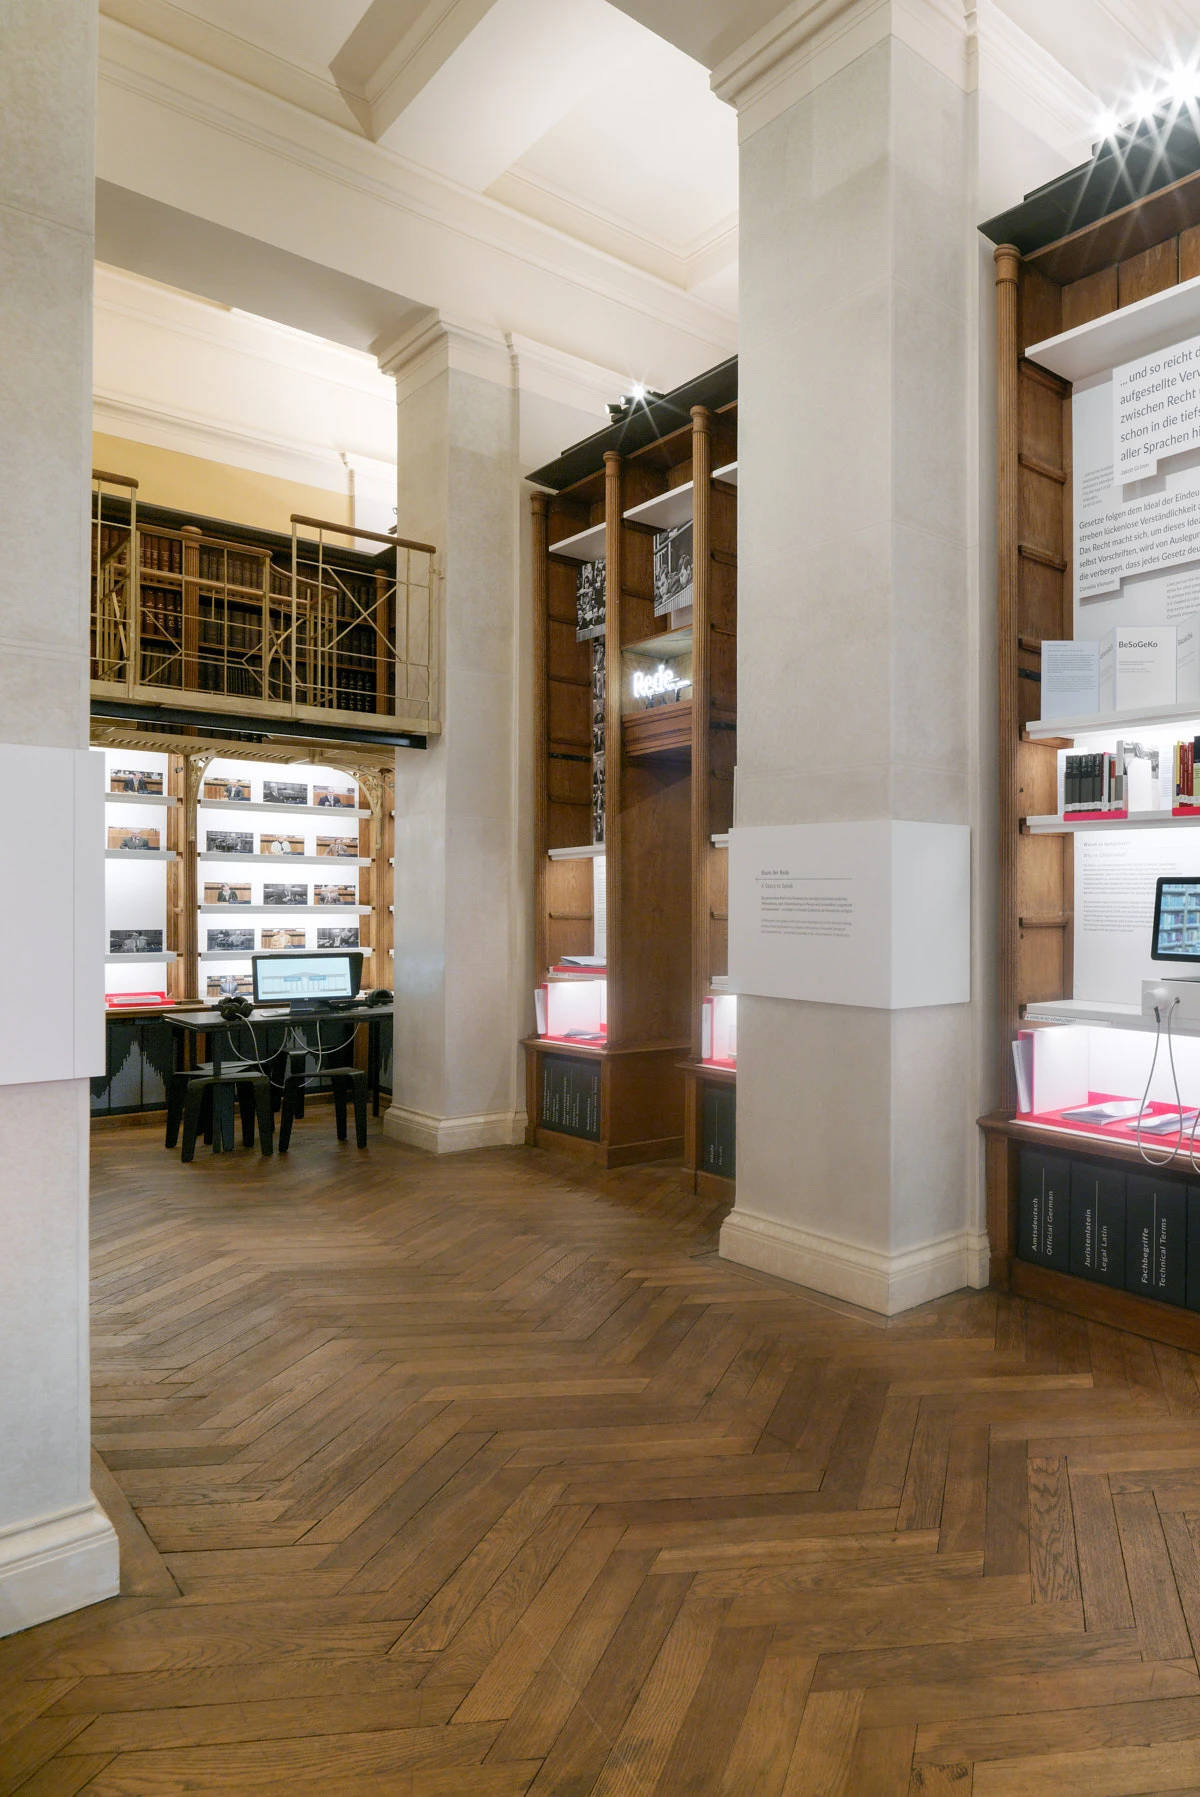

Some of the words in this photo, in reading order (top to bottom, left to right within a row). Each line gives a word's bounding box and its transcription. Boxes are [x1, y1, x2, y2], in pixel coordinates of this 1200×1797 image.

[1150, 364, 1160, 375] so
[1164, 351, 1192, 370] reicht
[1120, 377, 1177, 405] aufgestellte
[1120, 401, 1164, 423] zwischen
[1168, 389, 1196, 407] Recht
[1121, 427, 1148, 442] schon
[1152, 422, 1159, 432] in
[1163, 416, 1177, 428] die
[1121, 448, 1140, 462] aller
[1144, 430, 1189, 454] Sprachen
[1134, 463, 1149, 471] Grimm
[1079, 516, 1104, 529] Gesetze
[1106, 510, 1126, 522] folgen
[1128, 506, 1142, 516] dem
[1144, 499, 1160, 510] Ideal
[1080, 529, 1105, 542] streben
[1104, 520, 1138, 534] lückenlose
[1140, 503, 1196, 526] Verständlichkeit
[1080, 544, 1094, 555] Das
[1093, 540, 1110, 551] Recht
[1112, 535, 1132, 546] macht
[1151, 528, 1161, 536] um
[1163, 521, 1185, 533] dieses
[1080, 556, 1096, 568] selbst
[1139, 543, 1154, 553] wird
[1080, 572, 1089, 581] die
[1126, 559, 1140, 569] dass
[1142, 555, 1160, 567] jedes
[1162, 550, 1185, 560] Gesetz
[633, 665, 674, 698] Rede
